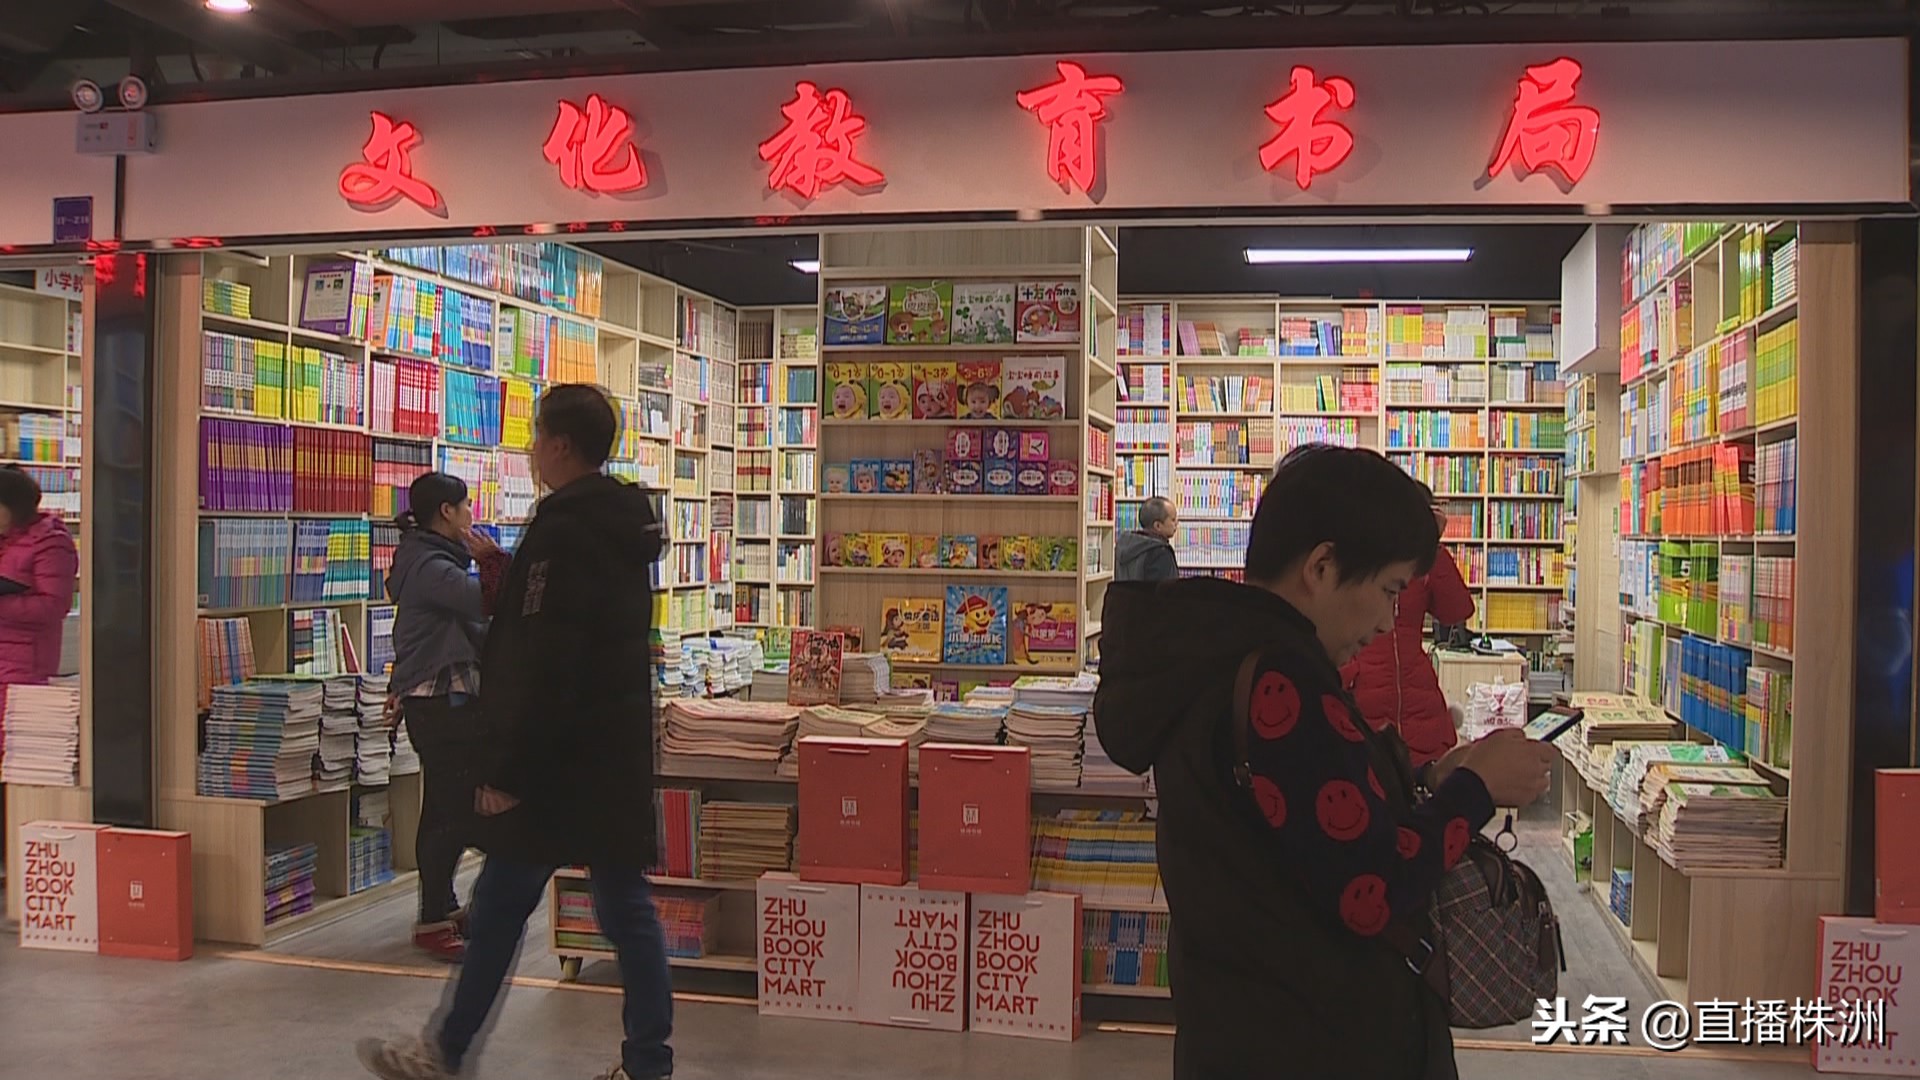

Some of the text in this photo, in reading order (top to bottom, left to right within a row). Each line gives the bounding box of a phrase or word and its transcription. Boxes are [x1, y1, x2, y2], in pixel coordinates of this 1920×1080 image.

[339, 59, 1601, 208] 文化教育书局
[25, 841, 60, 859] ZHU
[25, 859, 76, 878] ZHOU
[25, 877, 75, 896] BOOK
[26, 895, 67, 912] CITY
[764, 897, 806, 917] ZHU
[26, 914, 76, 931] MART
[764, 917, 826, 938] ZHOU
[895, 909, 958, 931] MART
[978, 910, 1021, 931] ZHU
[764, 938, 825, 958] BOOK
[904, 931, 958, 949] CITY
[977, 931, 1040, 953] ZHOU
[895, 949, 957, 972] BOOK
[1831, 941, 1881, 962] ZHU
[764, 957, 816, 976] CITY
[976, 952, 1038, 974] BOOK
[892, 971, 957, 992] ZHOU
[976, 972, 1029, 993] CITY
[1830, 963, 1902, 985] ZHOU
[764, 977, 826, 998] MART
[1828, 985, 1899, 1007] BOOK
[911, 992, 955, 1013] ZHU
[976, 993, 1039, 1015] MART
